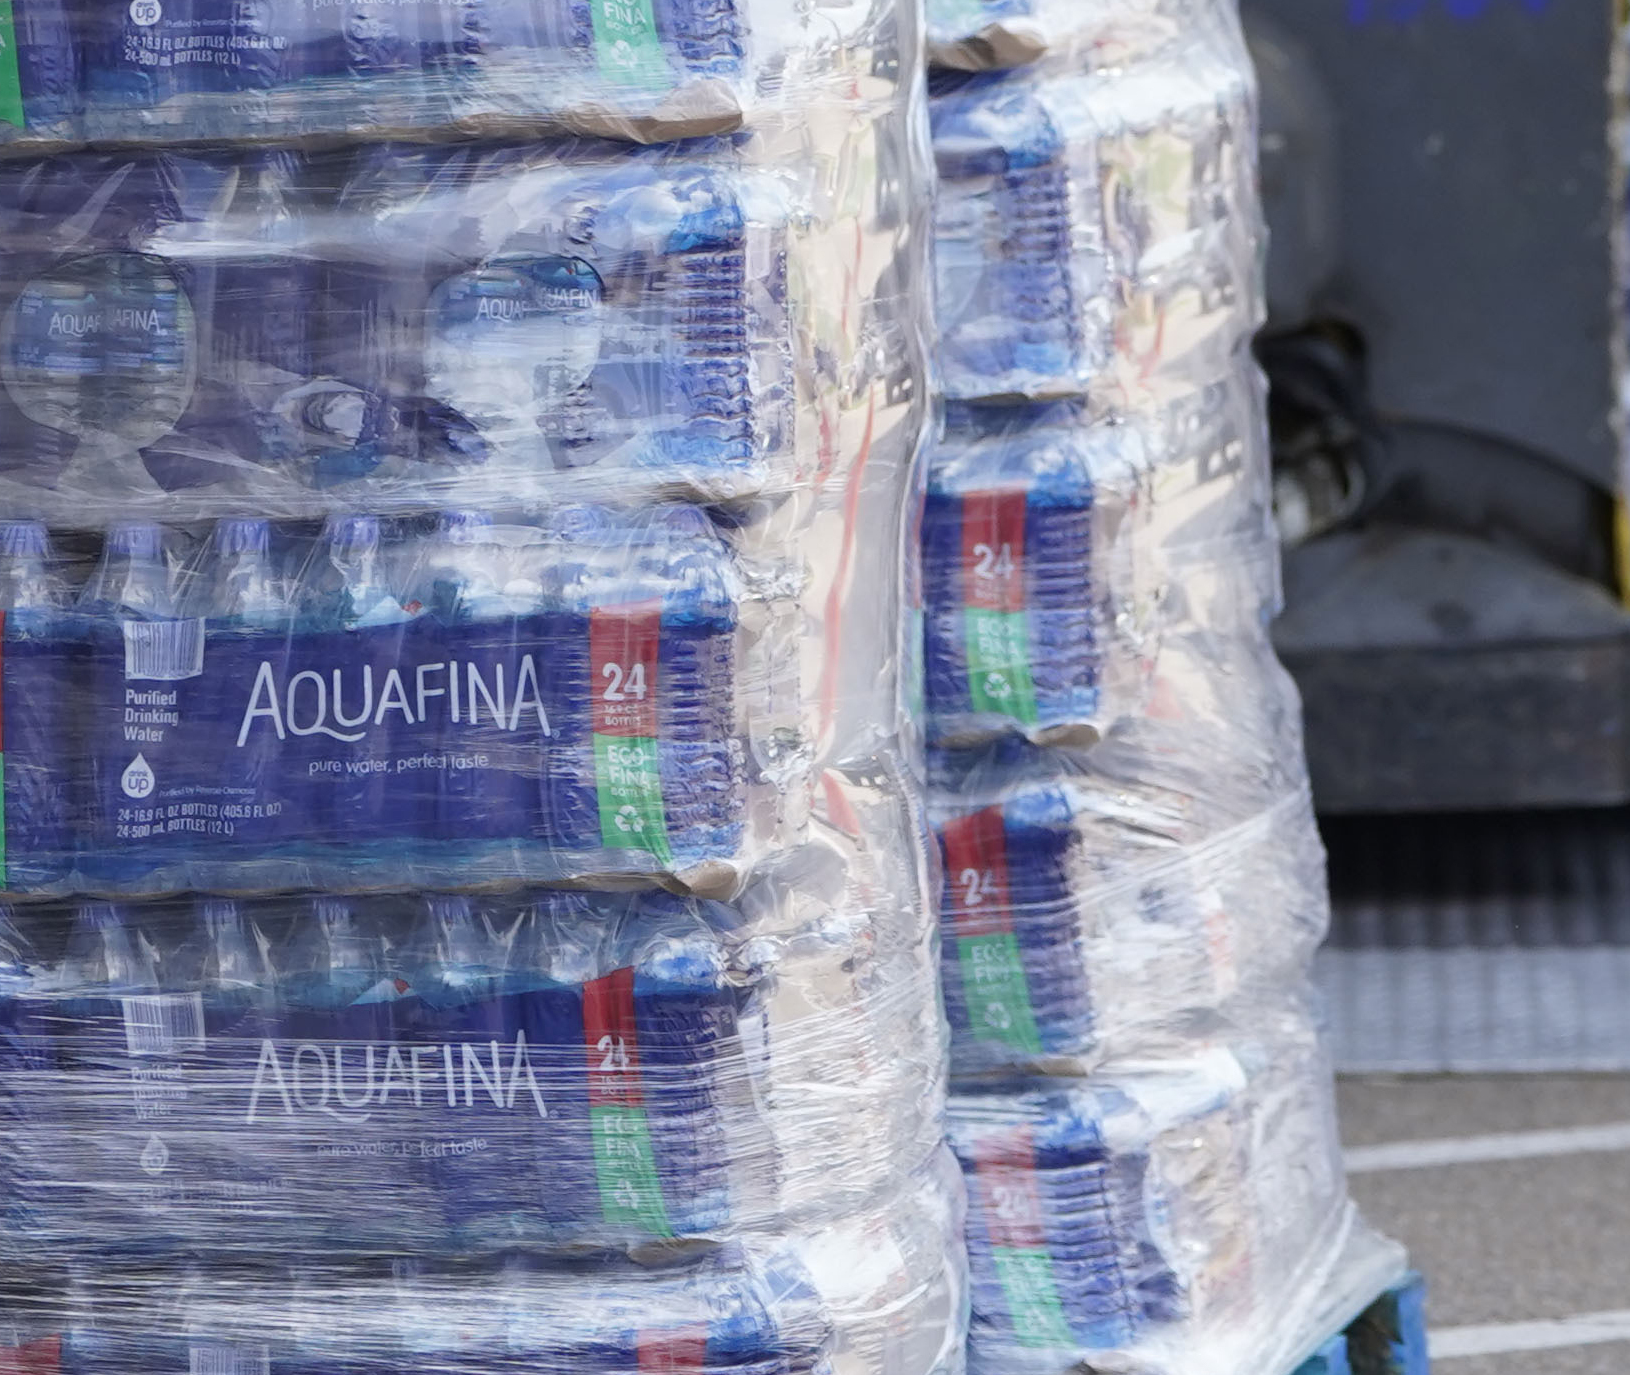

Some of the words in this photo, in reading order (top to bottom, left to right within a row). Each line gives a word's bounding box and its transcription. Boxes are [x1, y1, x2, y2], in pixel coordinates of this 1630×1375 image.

[603, 2, 647, 25] FINA
[972, 543, 1015, 580] 24
[602, 662, 647, 701] 24
[125, 689, 177, 706] Purified
[237, 654, 551, 747] AQUAFINA
[124, 708, 179, 726] Drinking
[124, 726, 165, 742] Water
[309, 759, 342, 777] pure
[345, 757, 392, 774] water,
[397, 754, 447, 772] perfect
[450, 753, 489, 770] taste
[128, 778, 149, 794] up
[118, 806, 154, 822] 24-16.9
[155, 806, 165, 820] FL
[167, 804, 180, 817] OZ
[181, 802, 218, 817] BOTTLES
[220, 803, 252, 820] (405.6
[253, 803, 264, 818] FL
[116, 823, 150, 839] 24-500
[167, 819, 206, 833] BOTTLES
[246, 1029, 547, 1124] AQUAFINA
